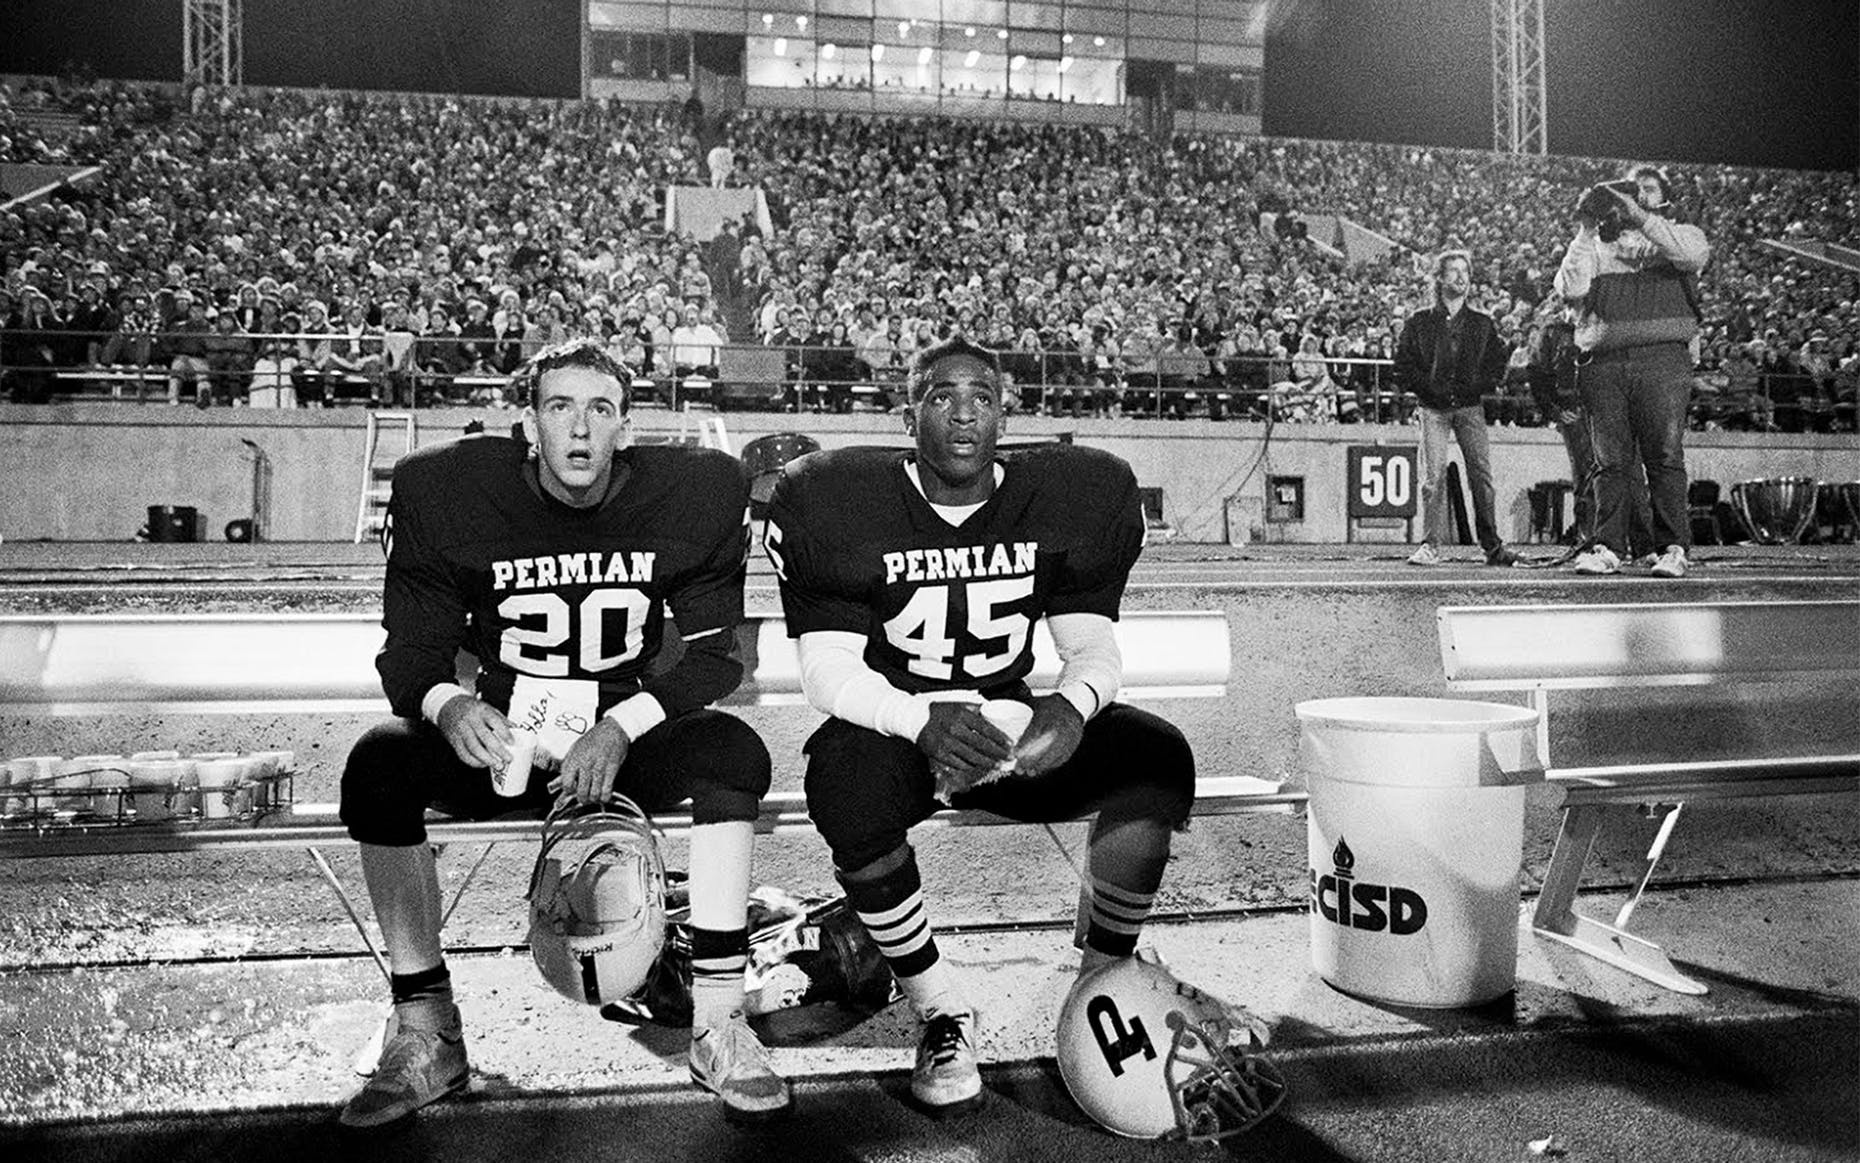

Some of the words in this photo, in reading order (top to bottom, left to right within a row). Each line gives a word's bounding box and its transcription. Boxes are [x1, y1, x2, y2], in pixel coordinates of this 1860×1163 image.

[1360, 455, 1410, 507] 50
[491, 552, 656, 590] PERMIAN
[882, 541, 1039, 585] PERMIAN
[497, 588, 651, 677] 20
[882, 574, 1036, 681] 45
[1310, 868, 1428, 935] CISD
